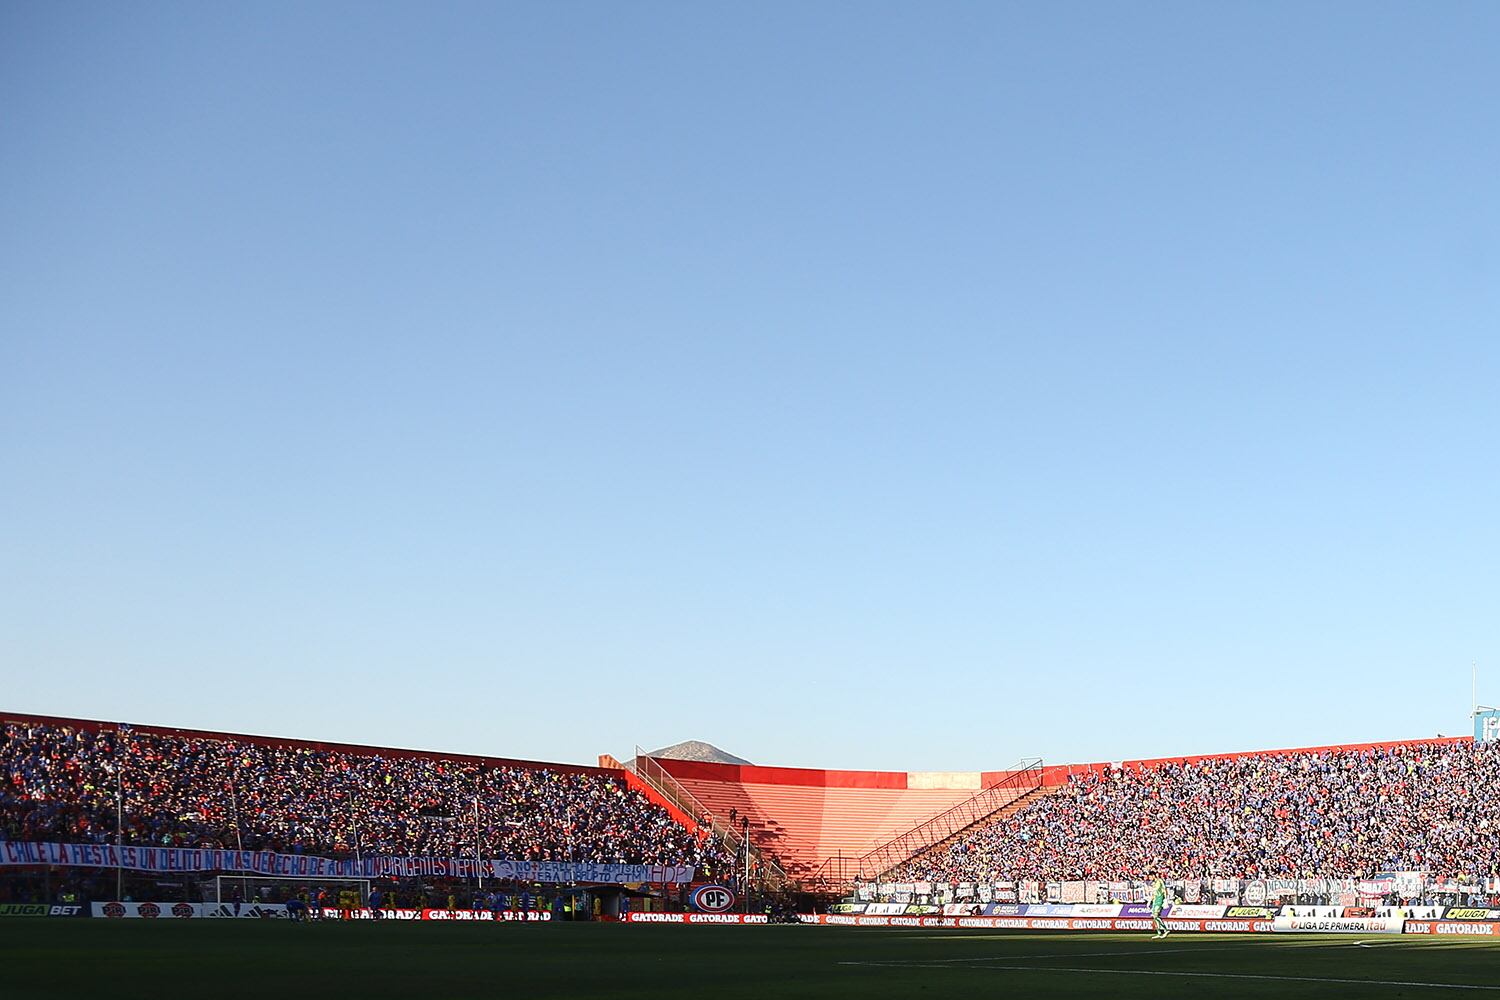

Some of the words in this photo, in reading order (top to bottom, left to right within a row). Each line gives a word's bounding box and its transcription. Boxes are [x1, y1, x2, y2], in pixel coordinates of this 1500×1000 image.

[6, 841, 48, 863] CHILE
[50, 843, 70, 864] LA
[72, 844, 118, 867] FIESTA
[121, 846, 136, 867] ES
[705, 891, 725, 907] PF
[50, 905, 82, 916] BET
[1460, 909, 1486, 919] JUGA
[632, 912, 684, 922] GATORADE
[690, 914, 739, 923] GATORADE
[1205, 921, 1249, 931] GATORADE
[1299, 922, 1317, 930] LIGA
[1320, 922, 1330, 930] DE
[1331, 922, 1364, 931] PRIMERA
[1436, 924, 1493, 934] GATORADE
